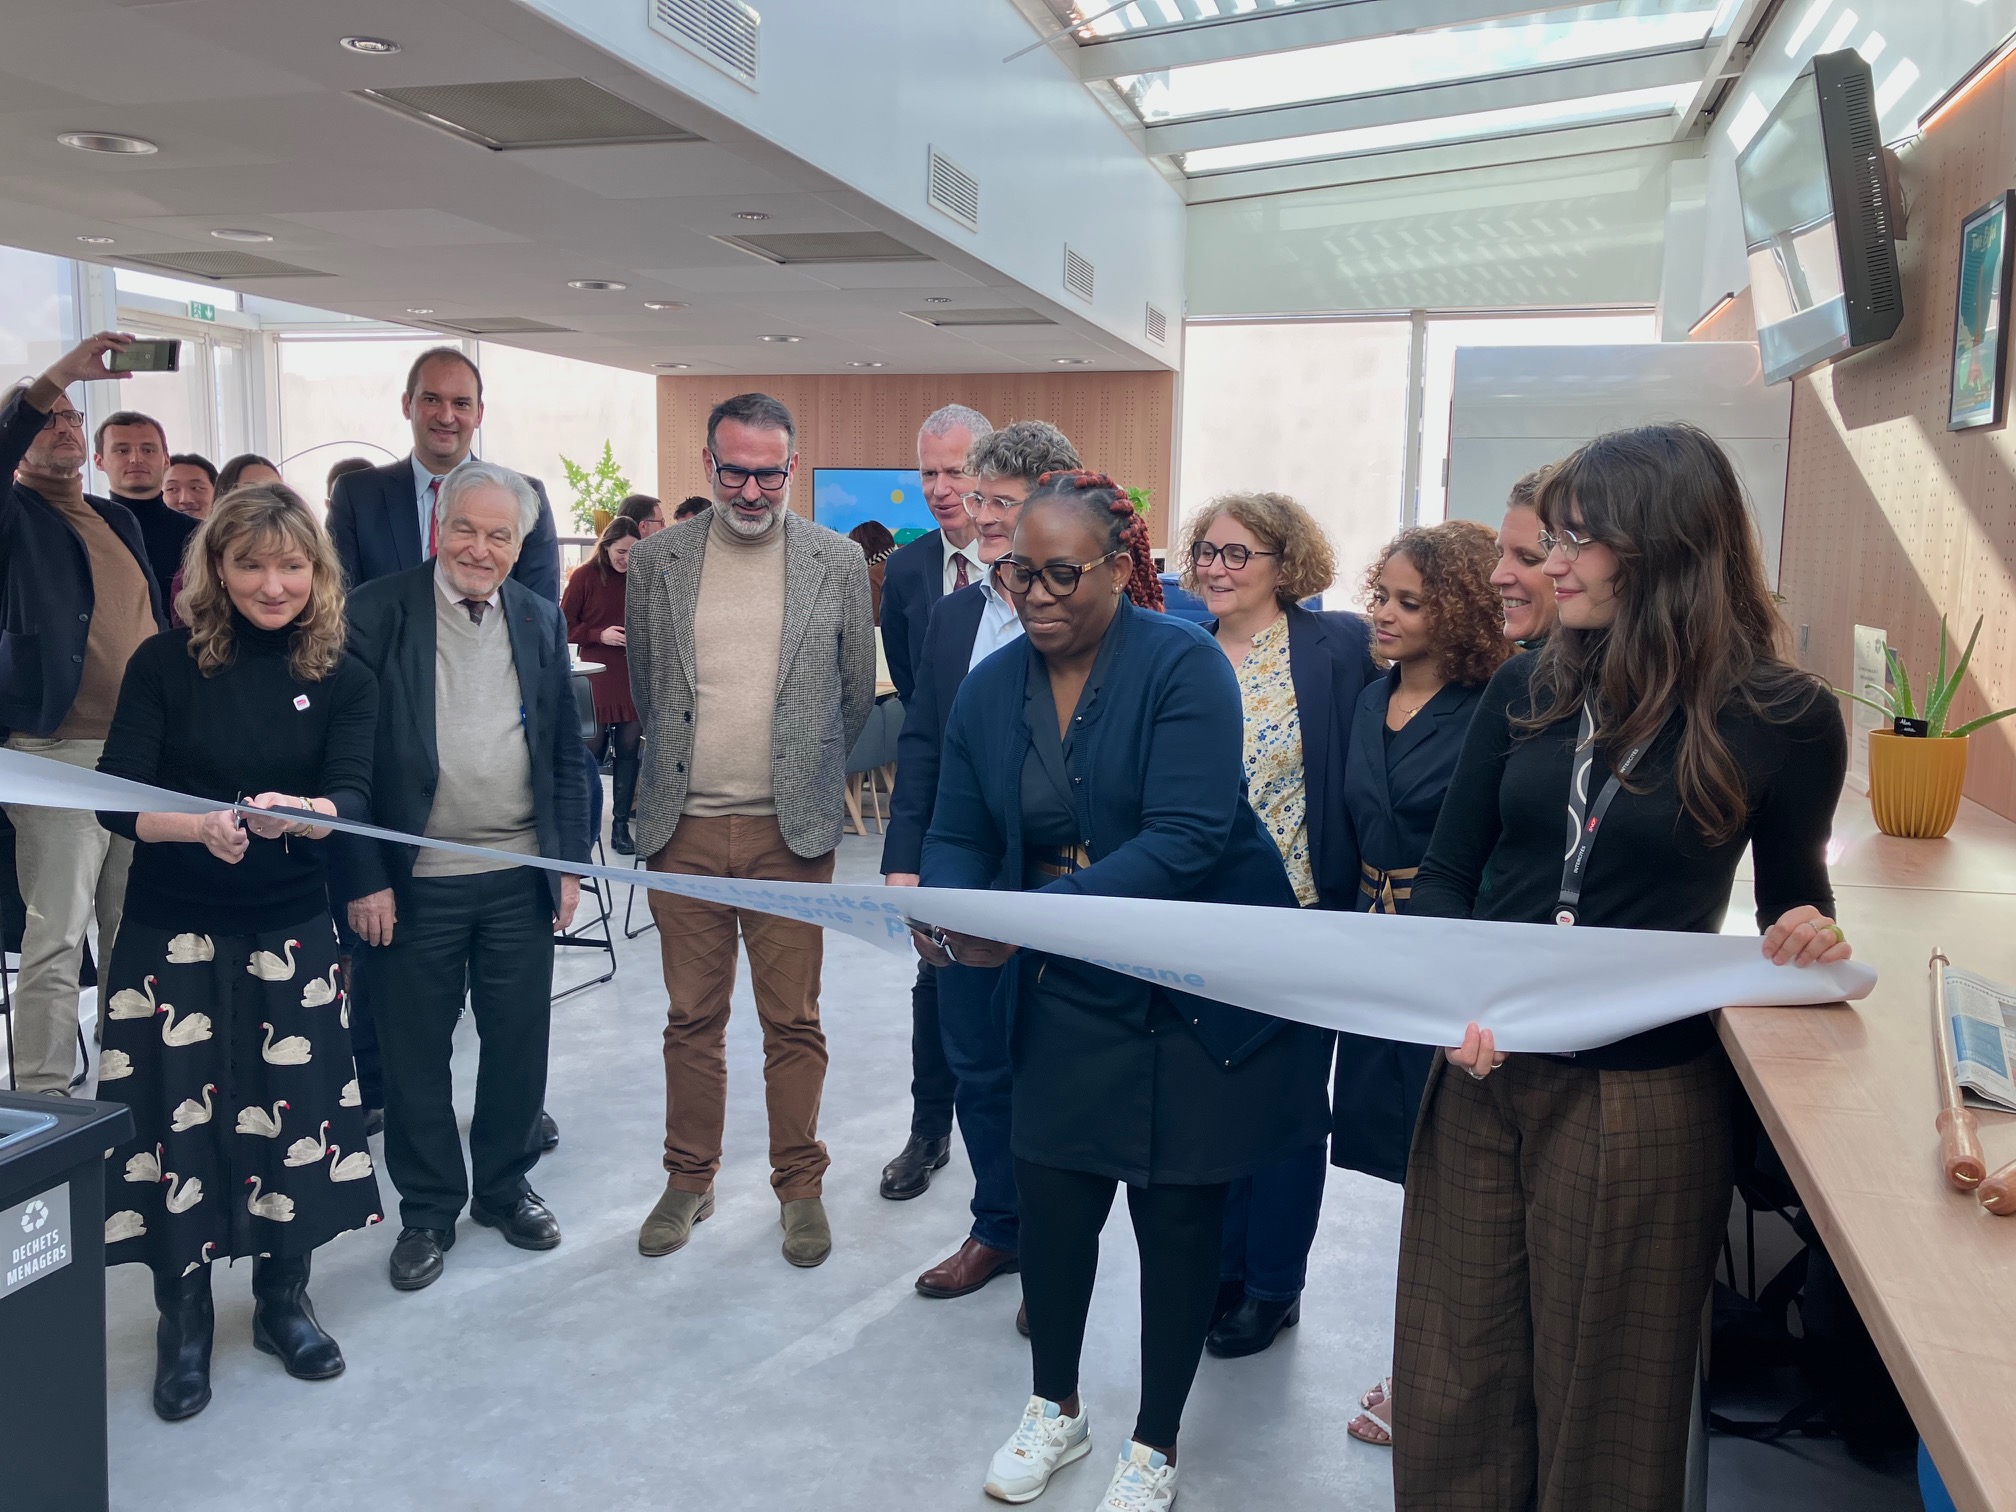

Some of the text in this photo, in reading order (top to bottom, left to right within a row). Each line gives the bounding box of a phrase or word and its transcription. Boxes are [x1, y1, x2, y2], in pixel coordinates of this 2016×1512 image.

[728, 885, 899, 914] Intercités
[12, 1229, 59, 1264] DECHETS
[6, 1244, 67, 1287] MENAGERS
